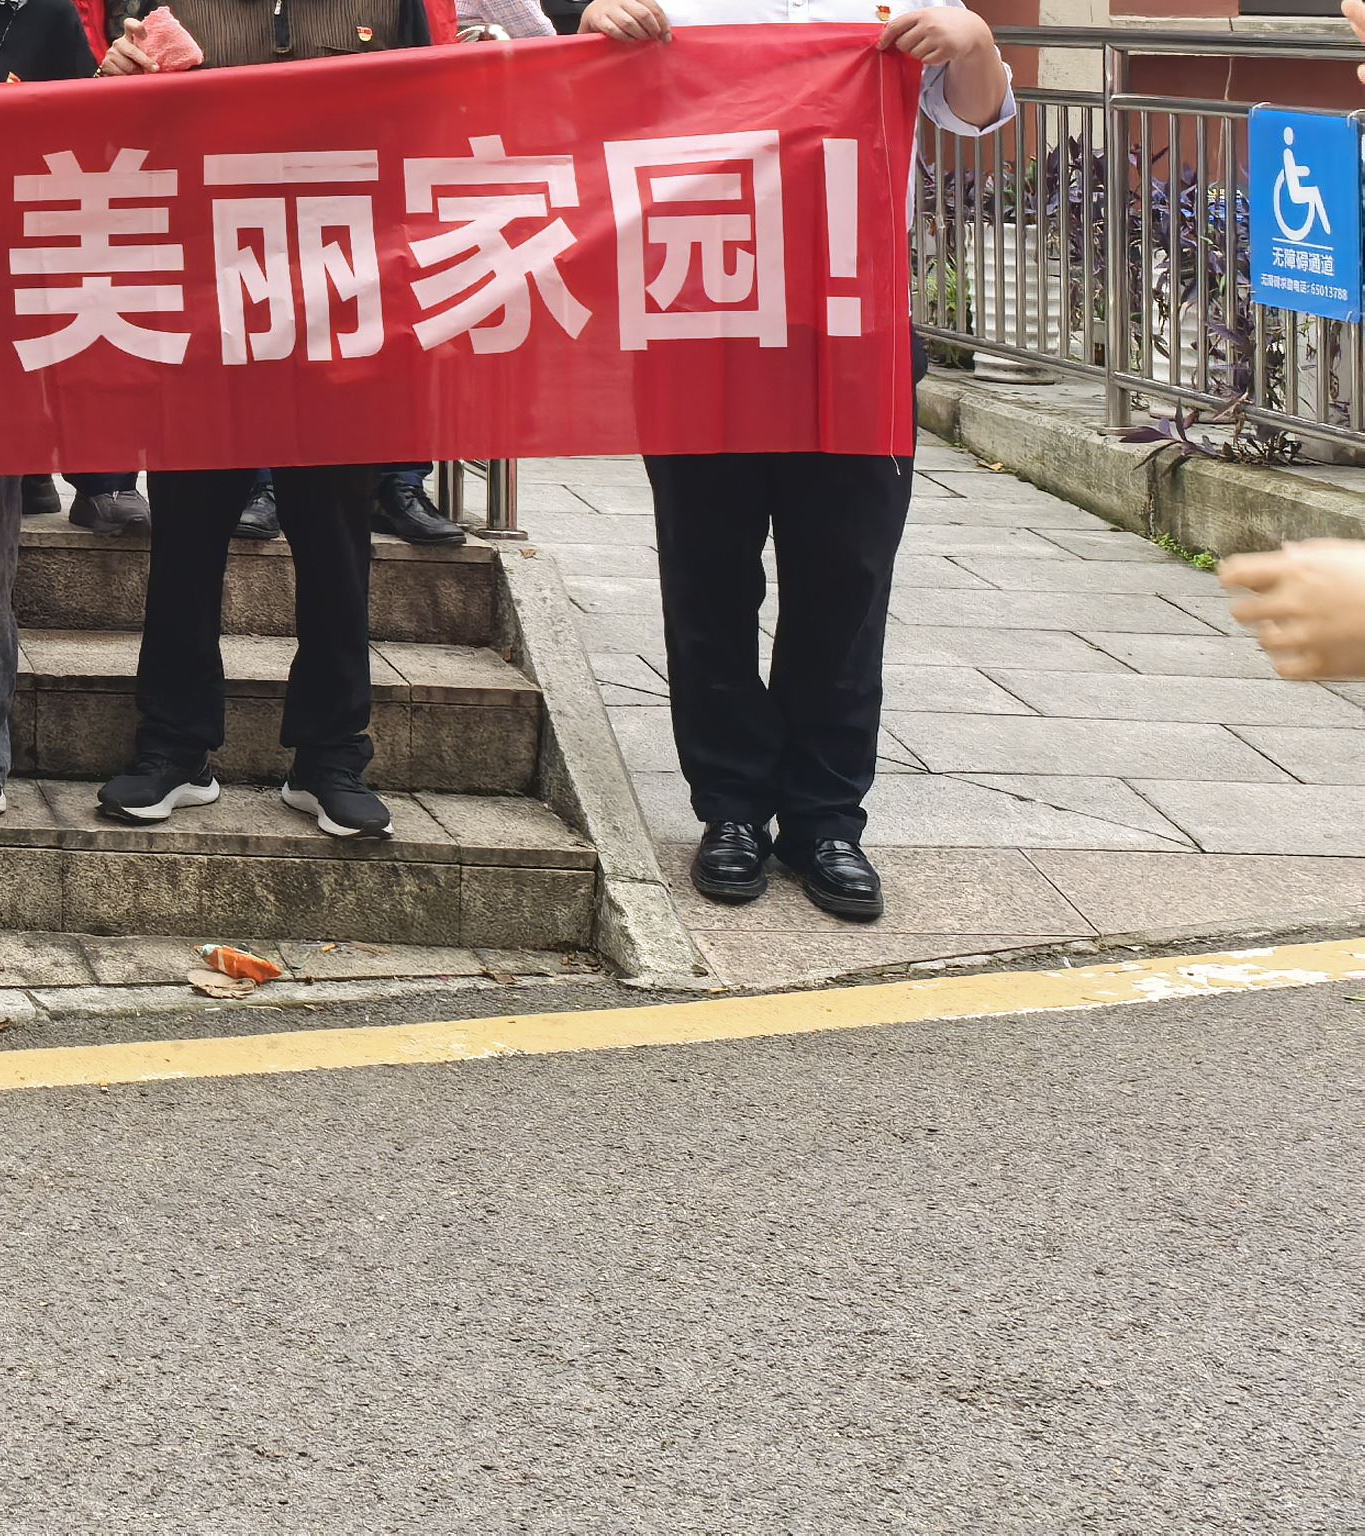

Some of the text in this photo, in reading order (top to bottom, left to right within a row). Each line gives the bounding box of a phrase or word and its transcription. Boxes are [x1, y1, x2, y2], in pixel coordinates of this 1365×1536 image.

[1272, 246, 1335, 277] 无障碍通道
